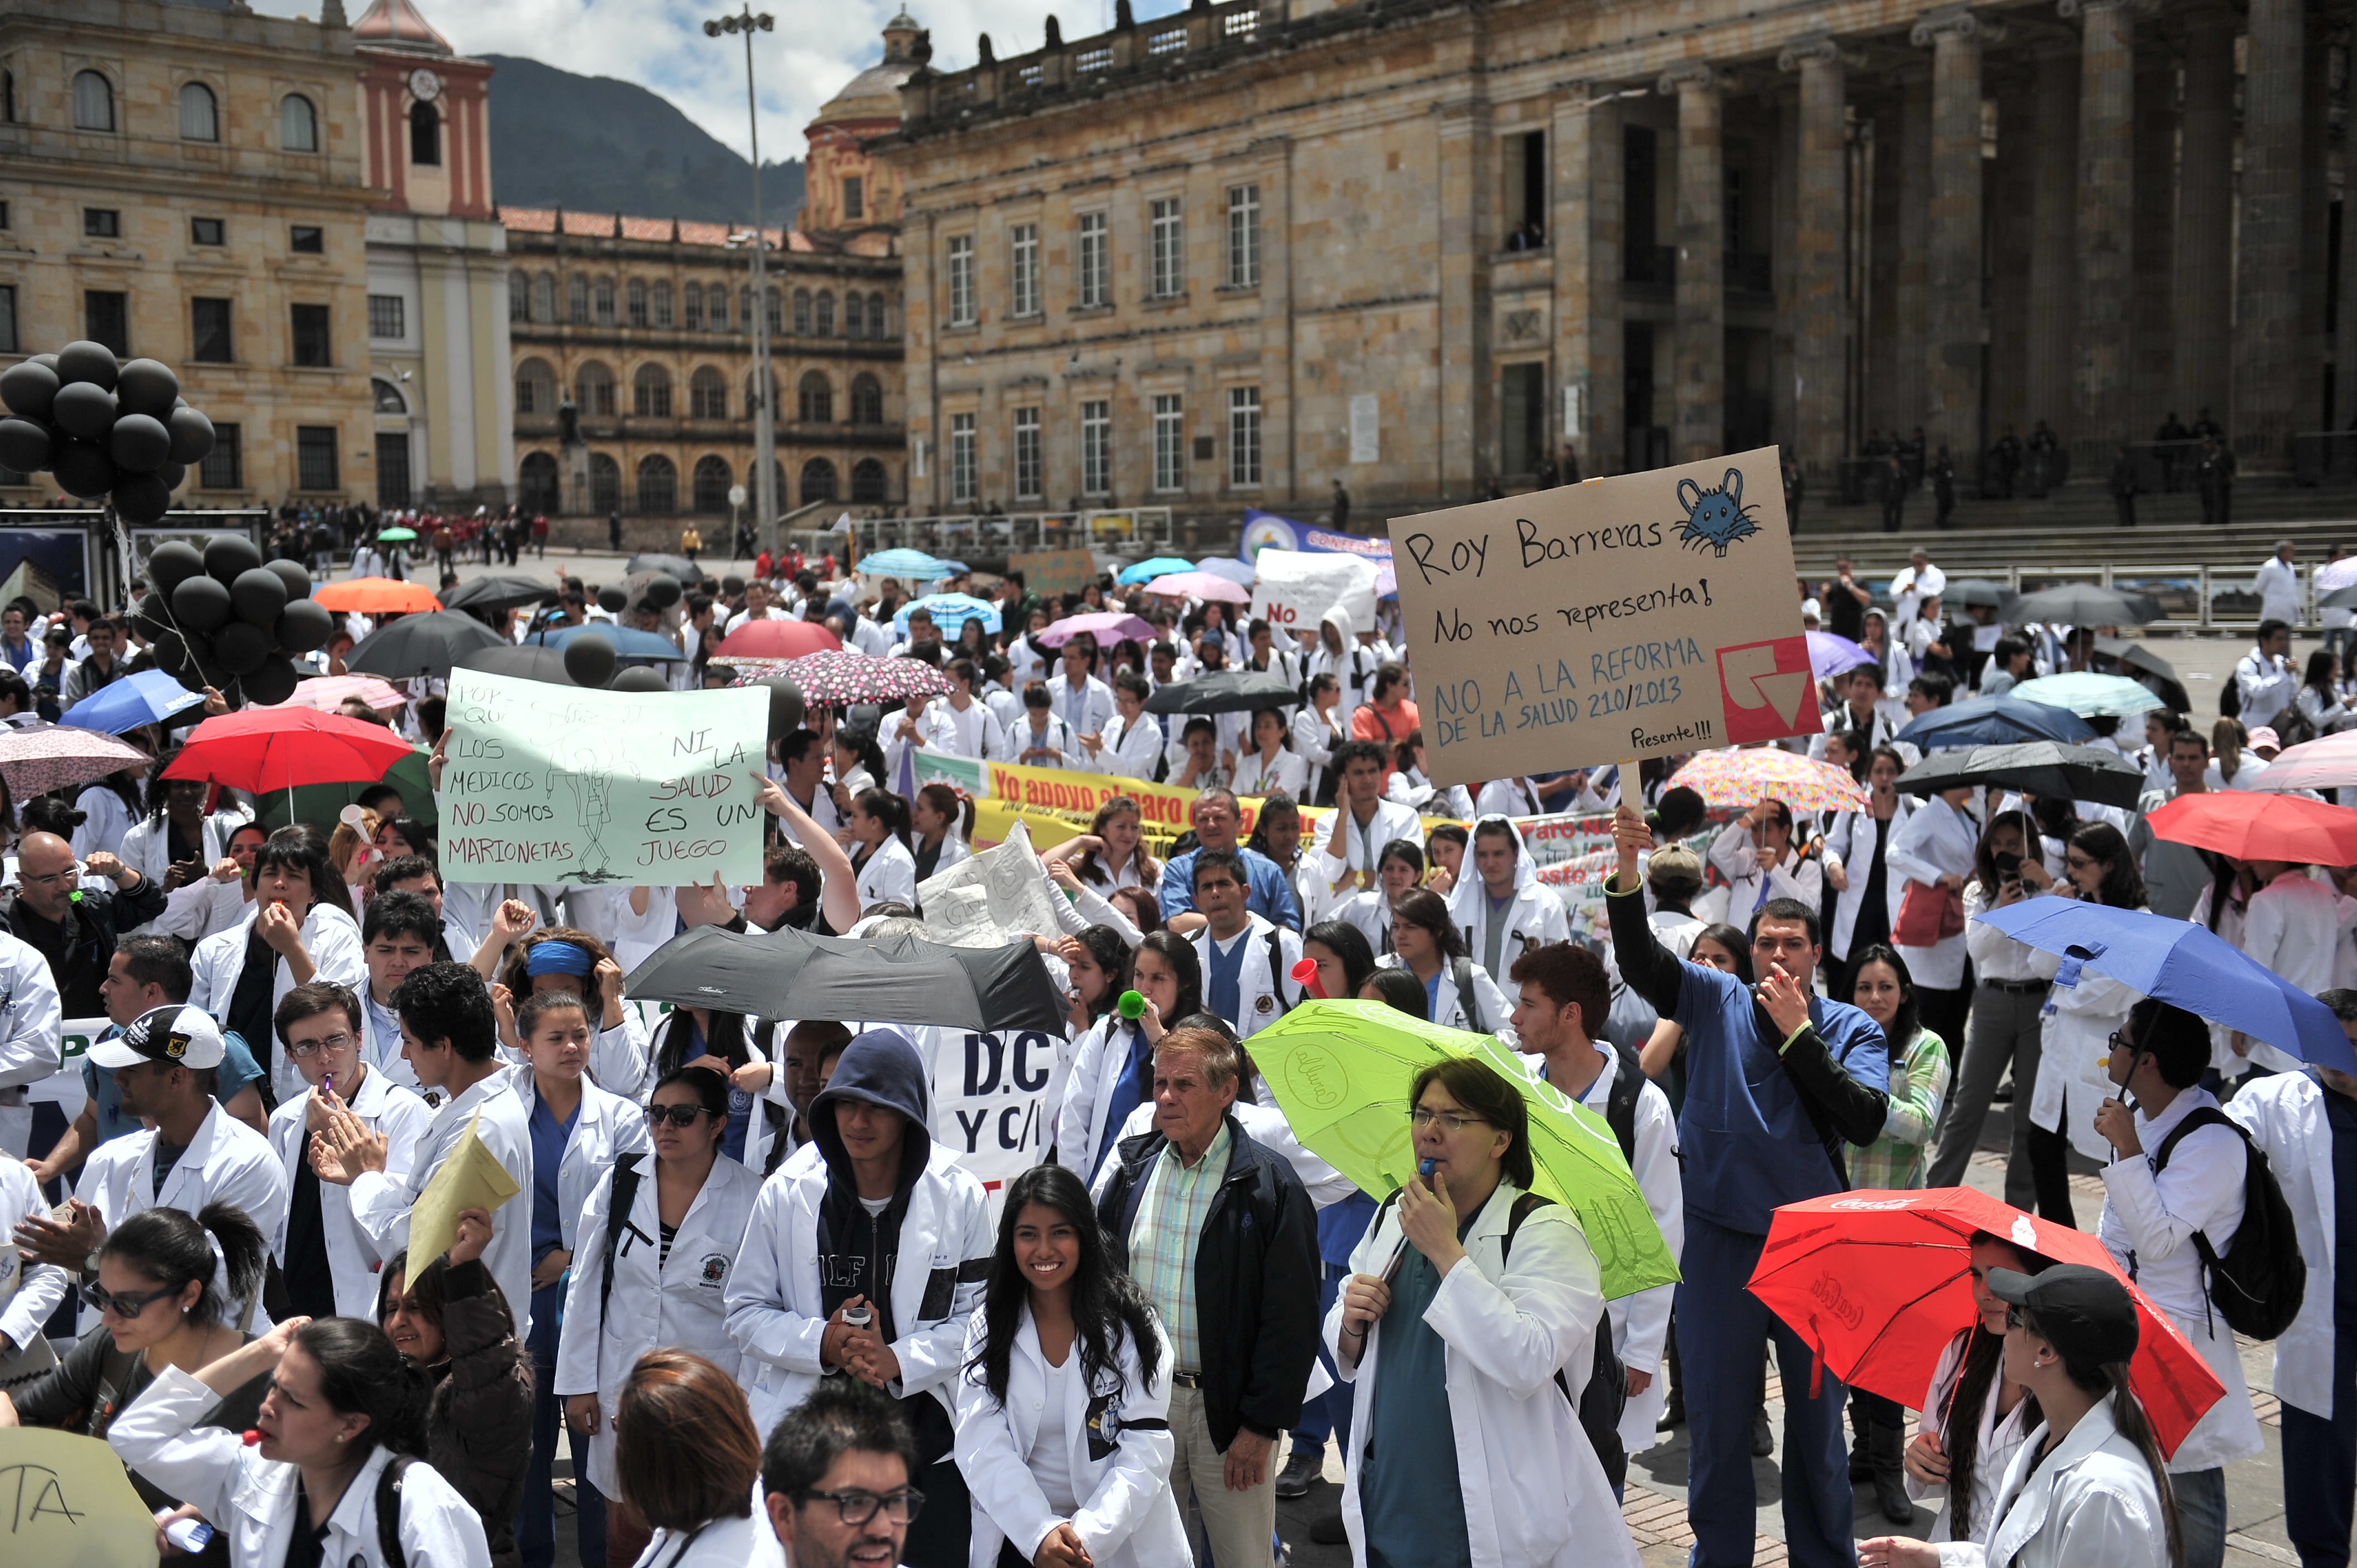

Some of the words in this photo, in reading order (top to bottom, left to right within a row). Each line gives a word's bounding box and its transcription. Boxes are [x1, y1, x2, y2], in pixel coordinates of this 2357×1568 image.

[1516, 518, 1662, 568] Barreras
[1267, 602, 1296, 623] No
[1434, 607, 1473, 643] No
[1488, 612, 1539, 636] nos
[1556, 577, 1712, 633] representa!
[1434, 680, 1481, 719] NO
[1504, 670, 1523, 706] A
[1538, 659, 1576, 694] LA
[1591, 637, 1706, 685] REFORMA
[1437, 717, 1467, 747] DE
[1480, 709, 1506, 737] LA
[1516, 698, 1578, 729] SALUD
[1587, 675, 1682, 718] 210/2013
[673, 728, 712, 757] NI
[1630, 720, 1712, 749] Presente!!!
[459, 738, 504, 759] LOS
[714, 742, 747, 769] LA
[449, 771, 534, 796] MEDICOS
[650, 775, 732, 800] SALUD
[995, 770, 1020, 801] Yo
[1026, 779, 1094, 811] apoyo
[452, 802, 485, 827] NO
[487, 803, 554, 823] SOMOS
[646, 807, 687, 832] ES
[717, 803, 756, 827] UN
[1519, 821, 1576, 840] Paro
[448, 837, 573, 864] MARIONETAS
[637, 839, 727, 865] JUEGO
[1536, 866, 1586, 885] osto
[955, 1109, 989, 1153] Y
